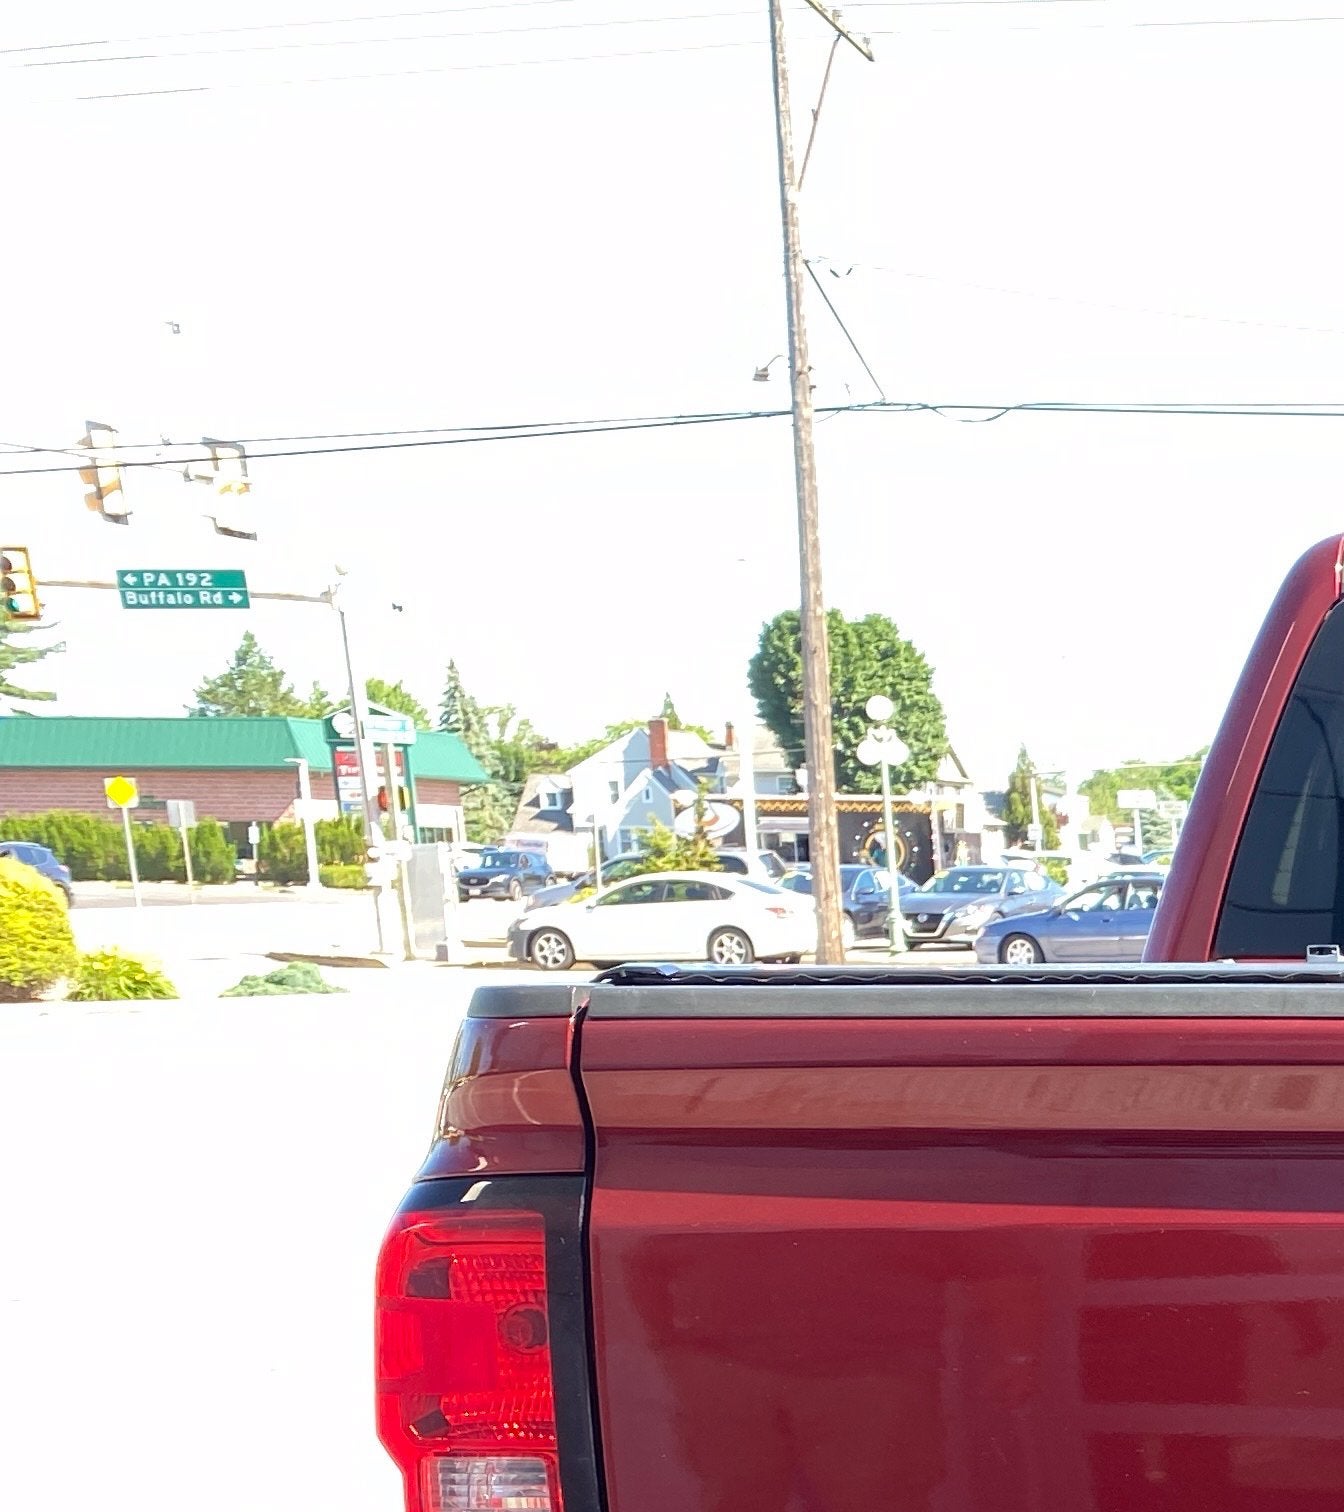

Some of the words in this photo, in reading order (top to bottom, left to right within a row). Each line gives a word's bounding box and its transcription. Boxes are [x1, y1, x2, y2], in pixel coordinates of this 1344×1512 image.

[142, 572, 171, 586] PA
[175, 572, 213, 586] 192
[124, 591, 194, 605] Buffalo
[198, 590, 223, 605] Rd
